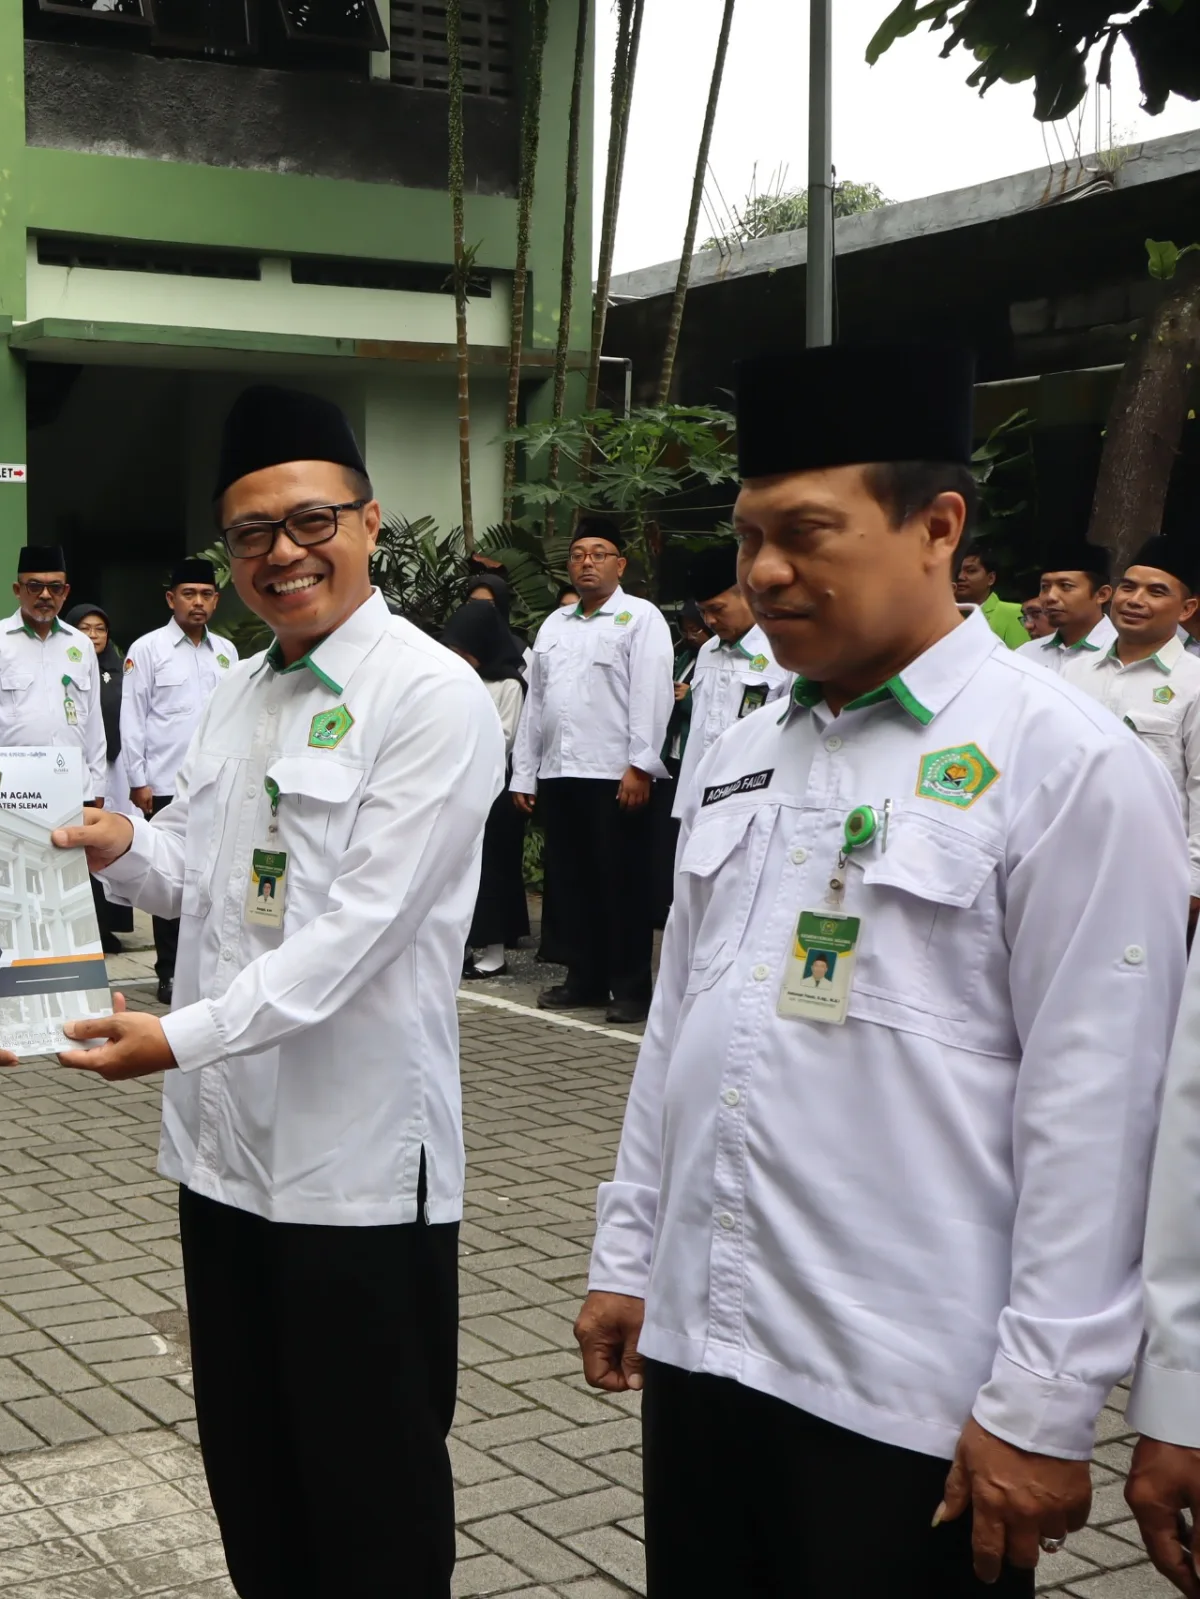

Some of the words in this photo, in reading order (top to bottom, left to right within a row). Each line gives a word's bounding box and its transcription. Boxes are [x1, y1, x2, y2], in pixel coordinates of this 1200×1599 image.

[740, 773, 768, 789] FAUZI
[9, 791, 42, 800] AGAMA
[18, 802, 48, 810] SLEMAN
